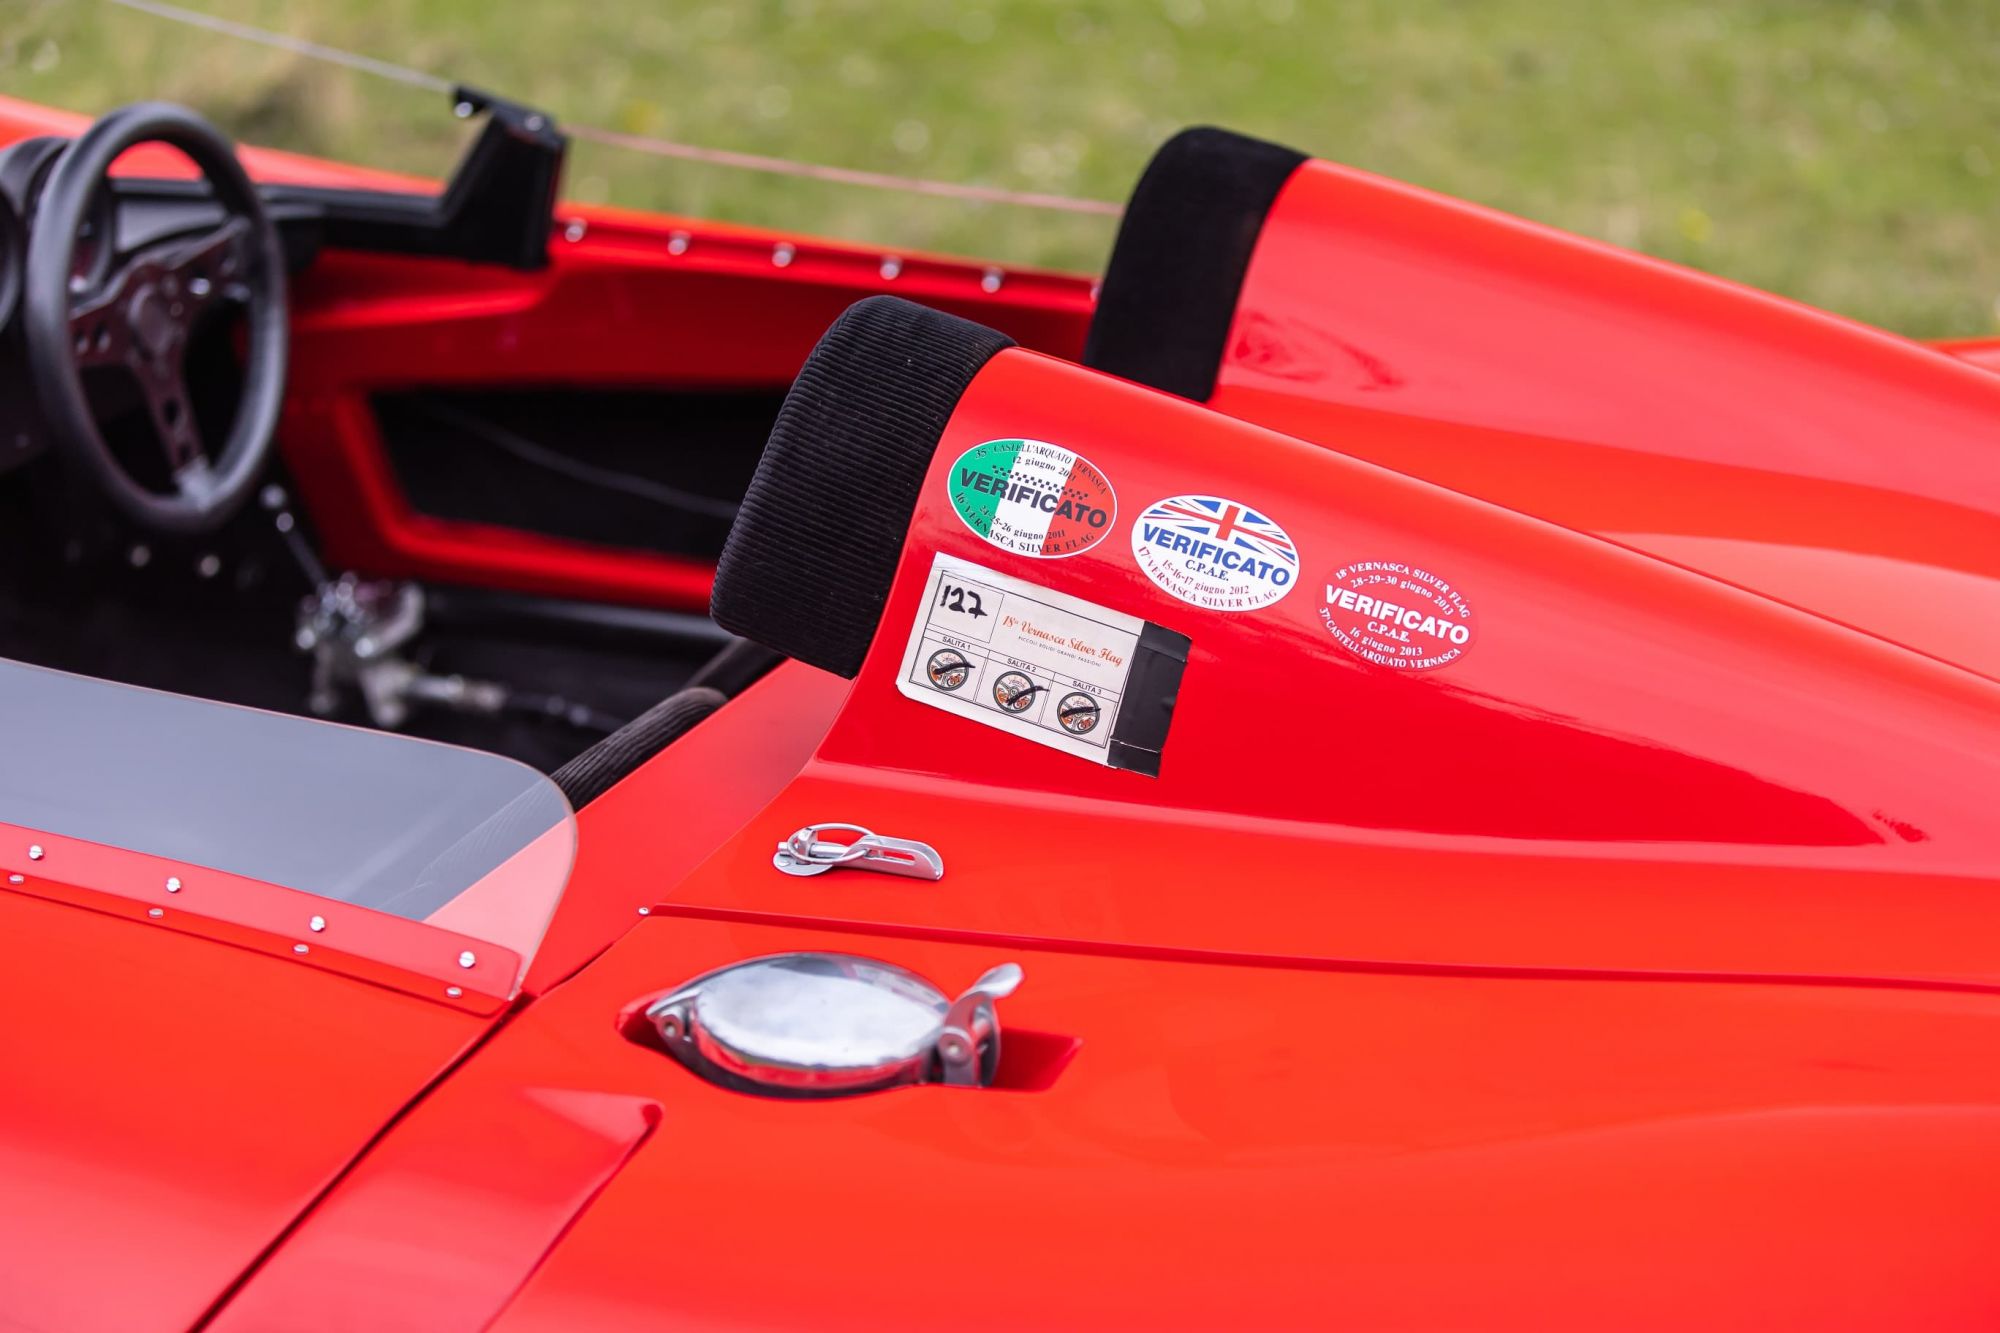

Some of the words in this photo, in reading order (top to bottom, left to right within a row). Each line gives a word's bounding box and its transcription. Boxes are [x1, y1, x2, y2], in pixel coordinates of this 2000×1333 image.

[993, 443, 1072, 464] CASTELL'ARQUATO
[1074, 461, 1108, 495] VERNASCA
[1012, 456, 1021, 464] 12
[1025, 458, 1056, 472] giugno
[1058, 466, 1076, 481] 2011
[960, 468, 1107, 529] VERIFICATO
[964, 505, 1015, 549] VERNASCA
[1018, 542, 1061, 553] SILVER
[1066, 533, 1095, 550] FLAG
[979, 505, 1012, 533] 24-25-26
[1014, 529, 1044, 541] giugno
[1047, 529, 1066, 540] 2011
[1143, 523, 1290, 586] VERIFICATO
[1185, 559, 1229, 582] C.P.A.E.
[1147, 559, 1197, 602] VERNASCA
[1201, 596, 1243, 608] SILVER
[1248, 589, 1277, 606] FLAG
[1162, 559, 1194, 585] 15-16-17
[1195, 582, 1225, 595] giugno
[1230, 585, 1250, 594] 2012
[1349, 561, 1410, 574] VERNASCA
[1413, 568, 1449, 594] SILVER
[1448, 591, 1471, 619] FLAG
[1350, 575, 1398, 589] 28-29-30
[1400, 580, 1433, 598] giugno
[1433, 595, 1454, 616] 2013
[940, 584, 988, 619] 127
[1326, 584, 1470, 644] VERIFICATO
[942, 636, 965, 650] SALITA
[1021, 619, 1065, 645] Vernasca
[1067, 637, 1097, 656] Silver
[1098, 648, 1122, 667] Flag
[1325, 619, 1407, 668] CASTELL'ARQUATO
[1410, 647, 1461, 669] VERNASCA
[1349, 626, 1360, 638] 16
[1361, 635, 1396, 654] giugno
[1399, 646, 1423, 656] 2013
[1367, 621, 1411, 643] C.P.A.E.
[1006, 658, 1029, 671] SALITA
[1072, 680, 1095, 693] SALITA
